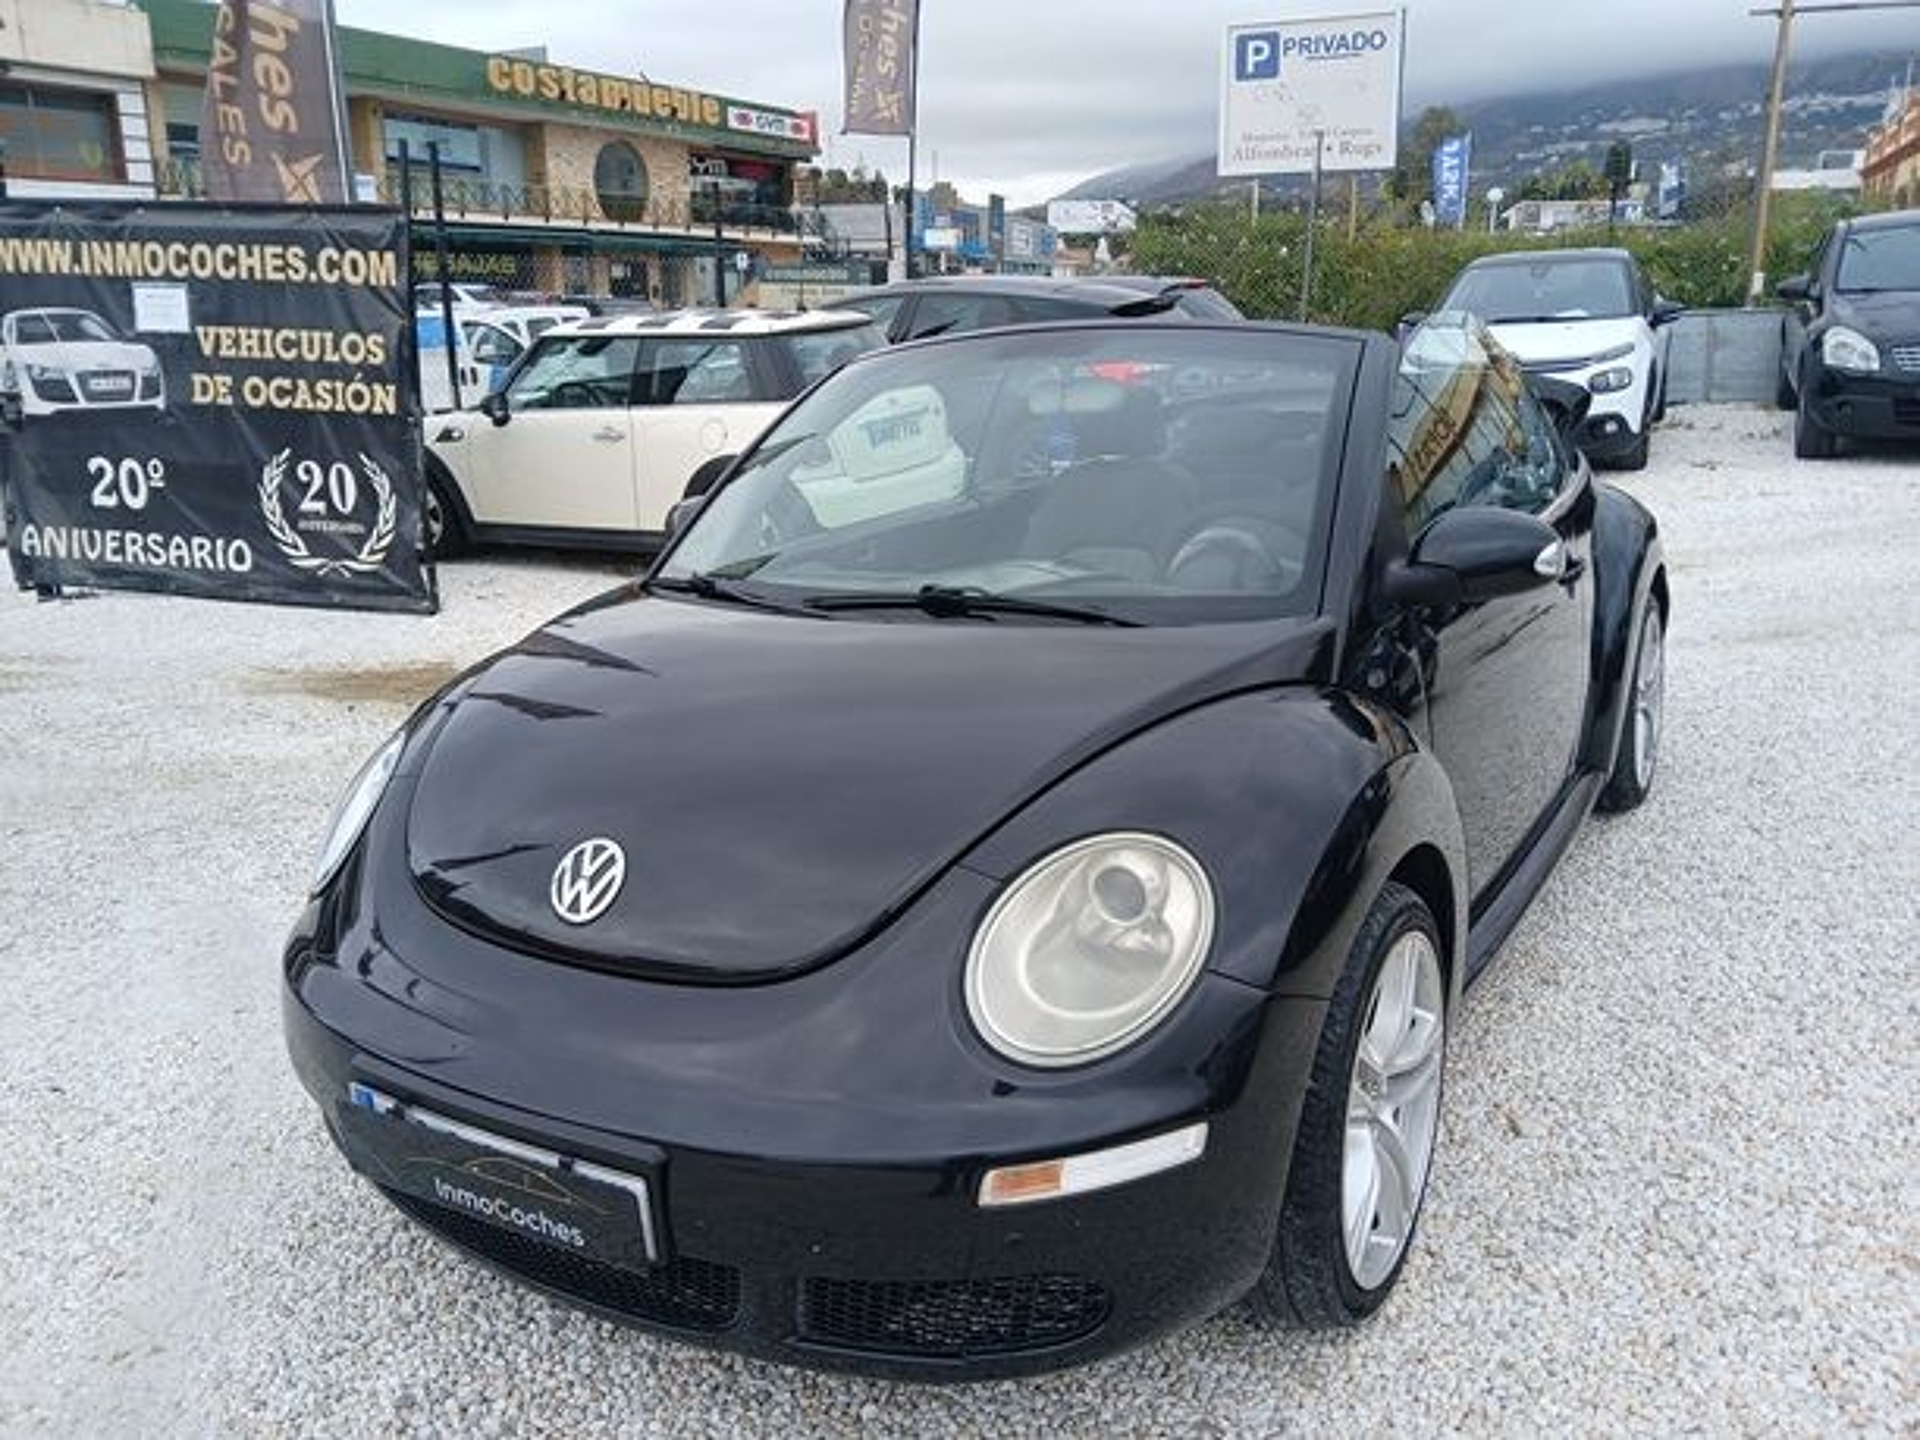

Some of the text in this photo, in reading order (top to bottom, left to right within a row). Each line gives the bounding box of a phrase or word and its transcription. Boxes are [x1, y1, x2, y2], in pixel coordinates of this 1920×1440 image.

[247, 0, 301, 133] hes
[1246, 29, 1387, 74] P PRIVADO
[195, 326, 385, 365] VEHICULOS
[191, 373, 397, 415] DE OCASIÓN
[297, 459, 358, 515] 20
[21, 523, 253, 573] ANIVERSARIO
[434, 1176, 586, 1248] InmoCoches
